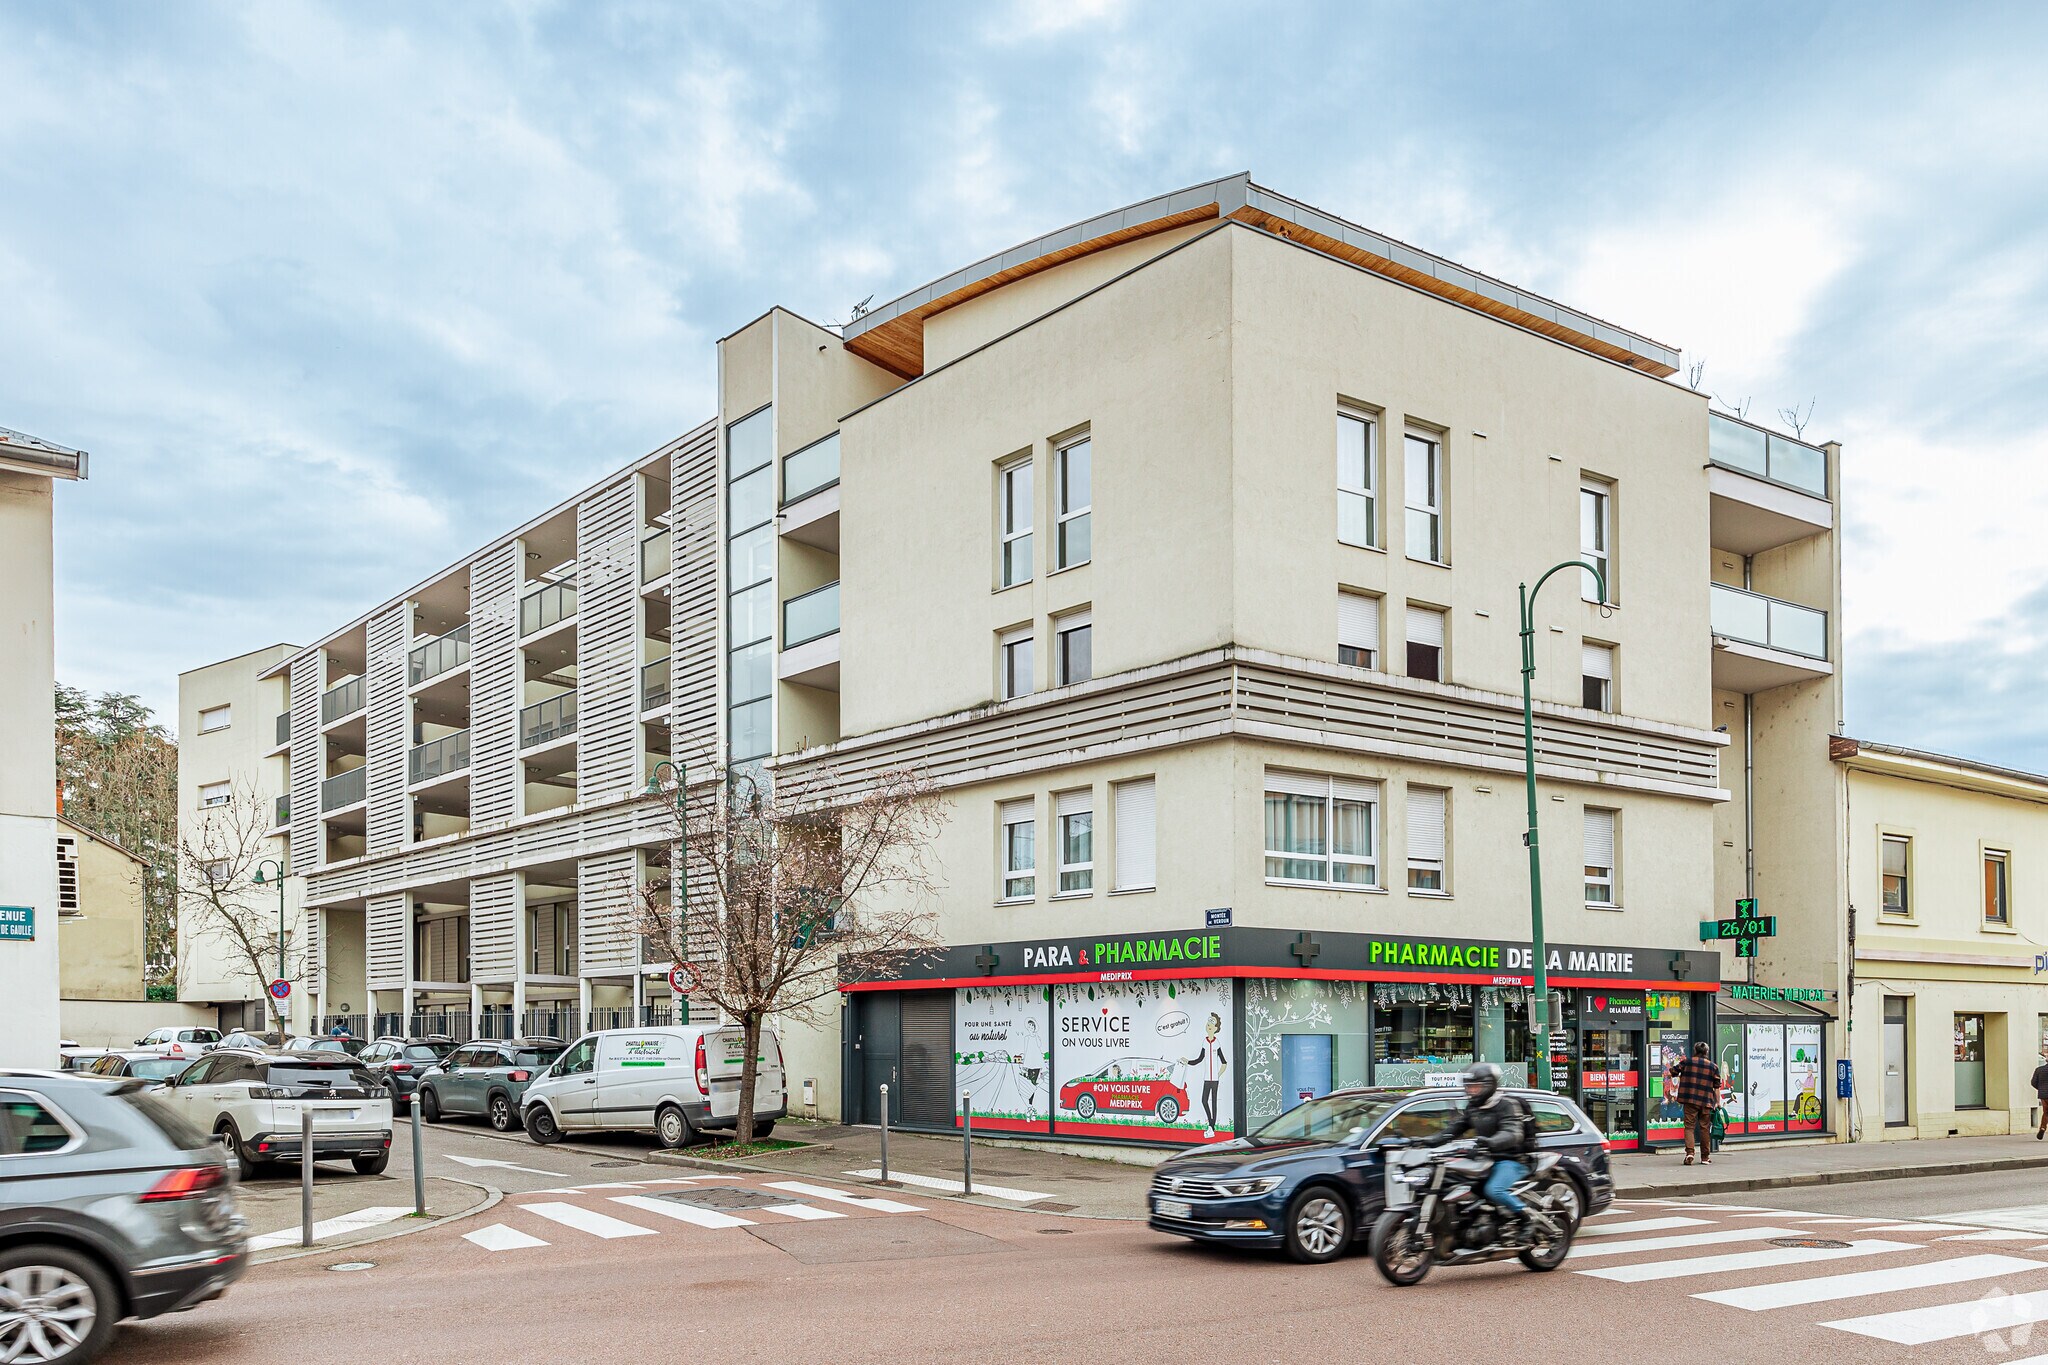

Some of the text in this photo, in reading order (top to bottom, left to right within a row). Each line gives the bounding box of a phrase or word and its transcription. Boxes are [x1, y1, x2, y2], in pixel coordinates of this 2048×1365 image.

[0, 910, 26, 921] ENUE
[1, 924, 32, 935] DE GAULLE
[1721, 920, 1767, 936] 26/01
[1024, 936, 1220, 967] PARA & PHARMACIE
[1369, 941, 1499, 968] PHARMACIE
[1506, 948, 1533, 969] DE
[1568, 951, 1633, 972] MAIRIE
[1100, 971, 1133, 981] MEDIPRIX
[1492, 977, 1522, 985] MEDIPRIX
[1732, 985, 1827, 1001] MATERIEL MEDICAL
[1586, 995, 1593, 1013] I
[1609, 997, 1642, 1006] Pharmacie
[1622, 1006, 1642, 1014] MAIRIE
[1061, 1016, 1130, 1032] SERVICE
[1157, 1023, 1170, 1032] C'est
[1170, 1018, 1185, 1030] gratuit
[969, 1029, 1007, 1041] au naturel
[1062, 1038, 1130, 1047] ON VOUS LIVRE
[1590, 1073, 1626, 1082] BIENVENUE
[1093, 1084, 1151, 1093] #ON VOUS LIVRE
[1109, 1100, 1143, 1108] MEDIPRIX
